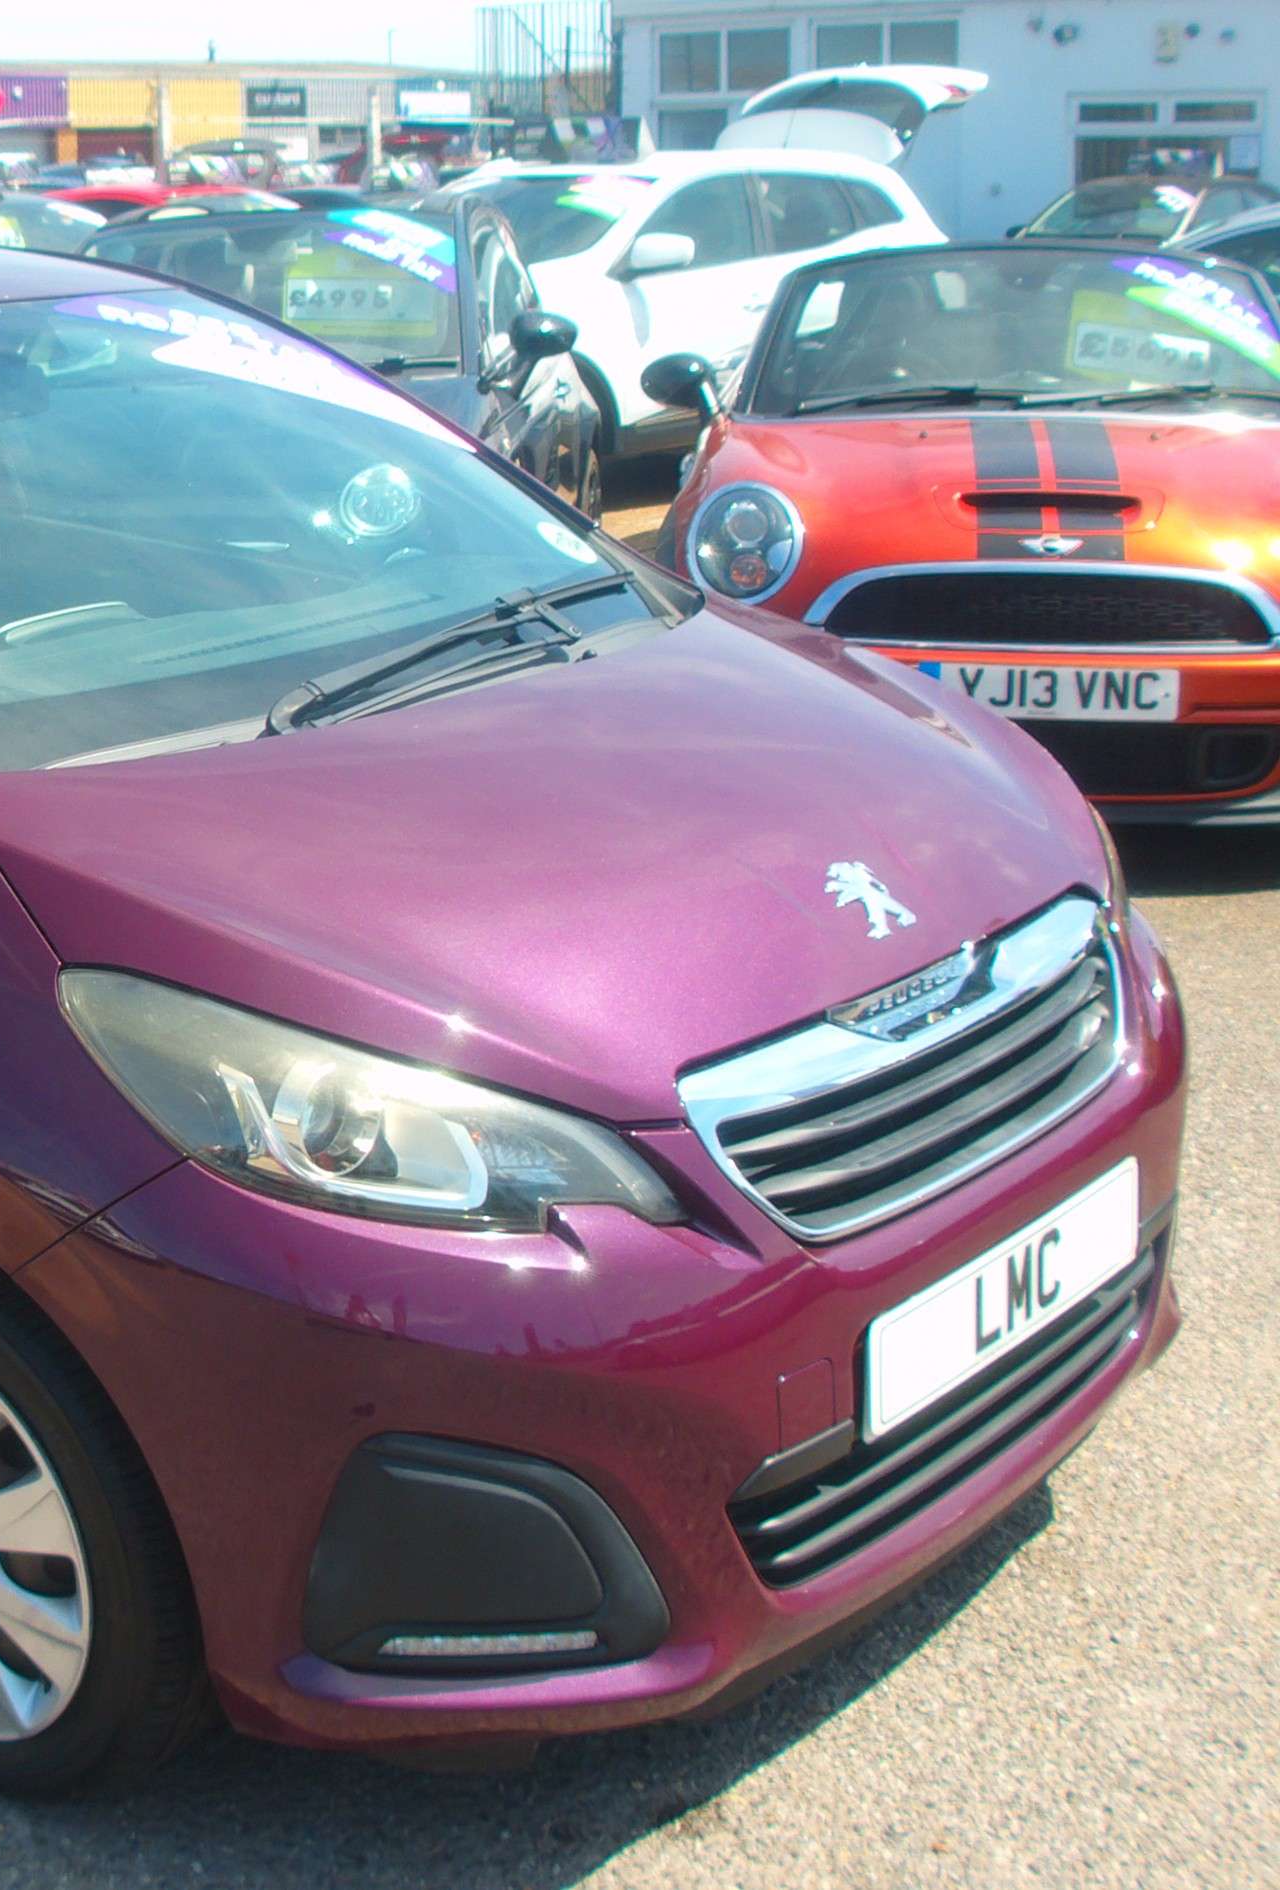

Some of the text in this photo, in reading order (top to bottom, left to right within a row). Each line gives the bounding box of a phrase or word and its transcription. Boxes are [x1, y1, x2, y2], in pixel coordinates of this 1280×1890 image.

[289, 288, 391, 309] £4995
[958, 667, 1161, 710] YJ13 VNC
[975, 1227, 1061, 1354] LMC
